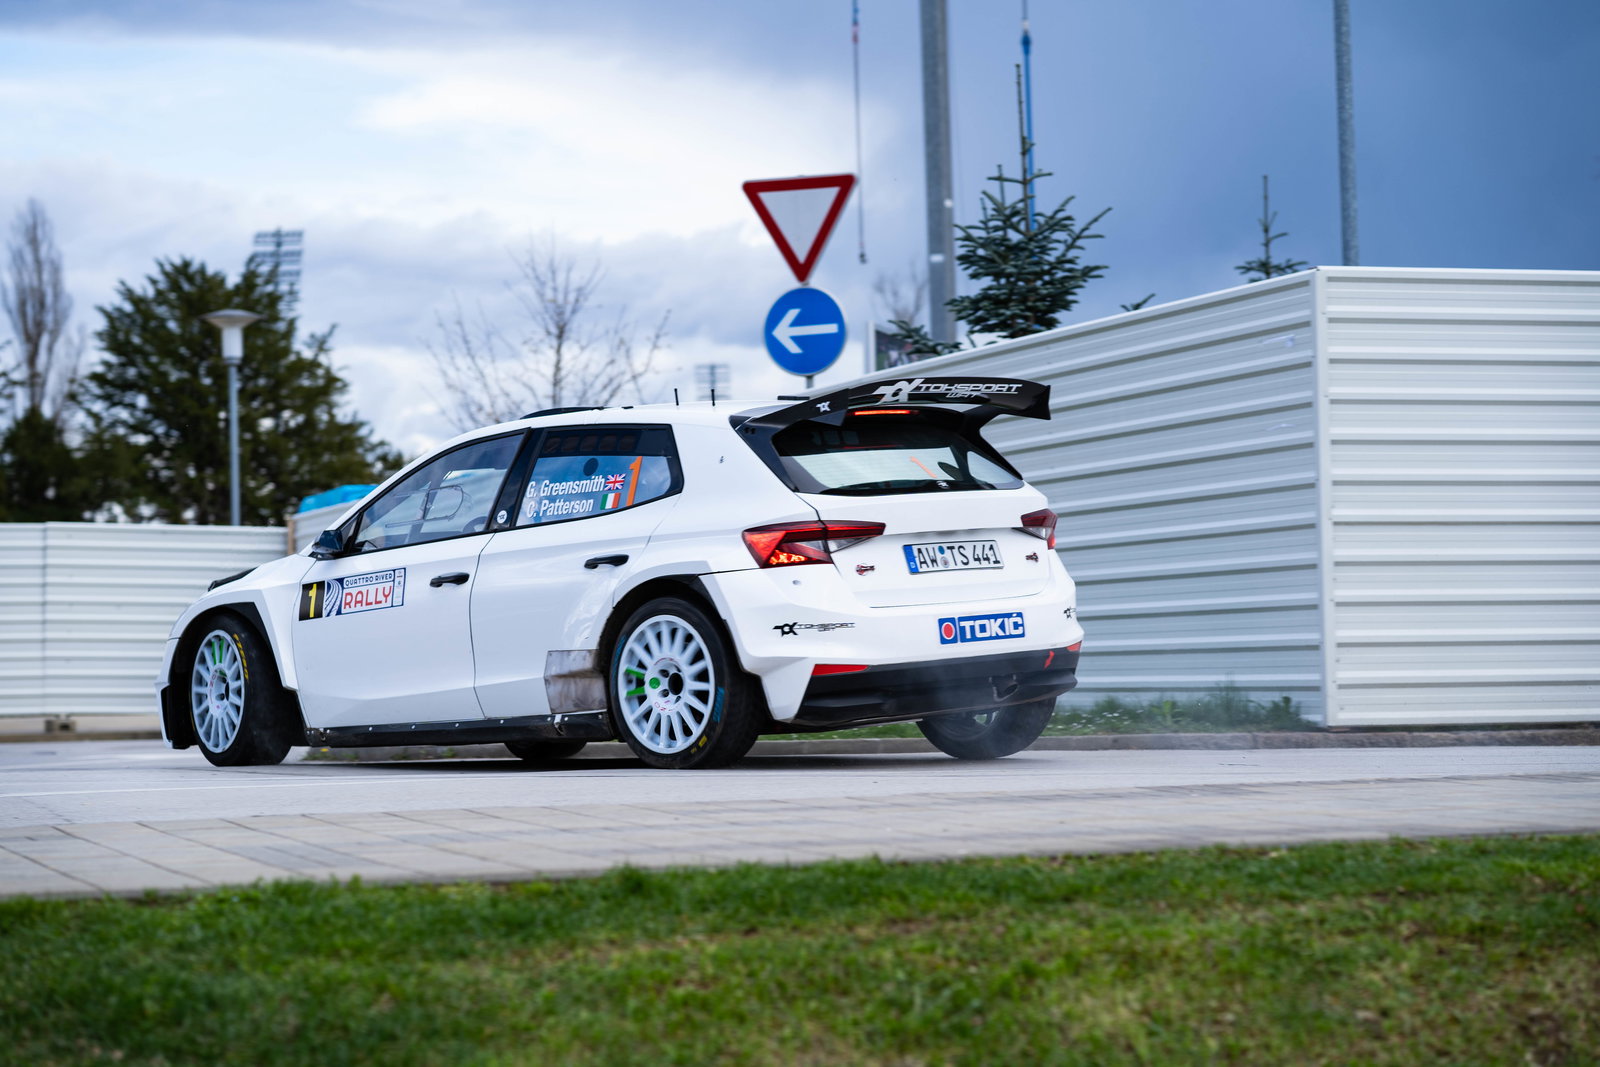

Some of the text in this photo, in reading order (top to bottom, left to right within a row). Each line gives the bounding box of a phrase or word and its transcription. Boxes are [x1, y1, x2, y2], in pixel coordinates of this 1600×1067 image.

[918, 383, 1023, 392] TOKSPORT
[526, 475, 605, 498] G. Greensmith
[625, 455, 643, 507] 1
[526, 499, 594, 518] C. Patterson
[917, 544, 1001, 569] AW TS 441
[345, 572, 393, 587] QUATTRO RIVER
[308, 583, 317, 618] 1
[343, 585, 392, 610] RALLY
[959, 613, 1024, 640] TOKIĆ
